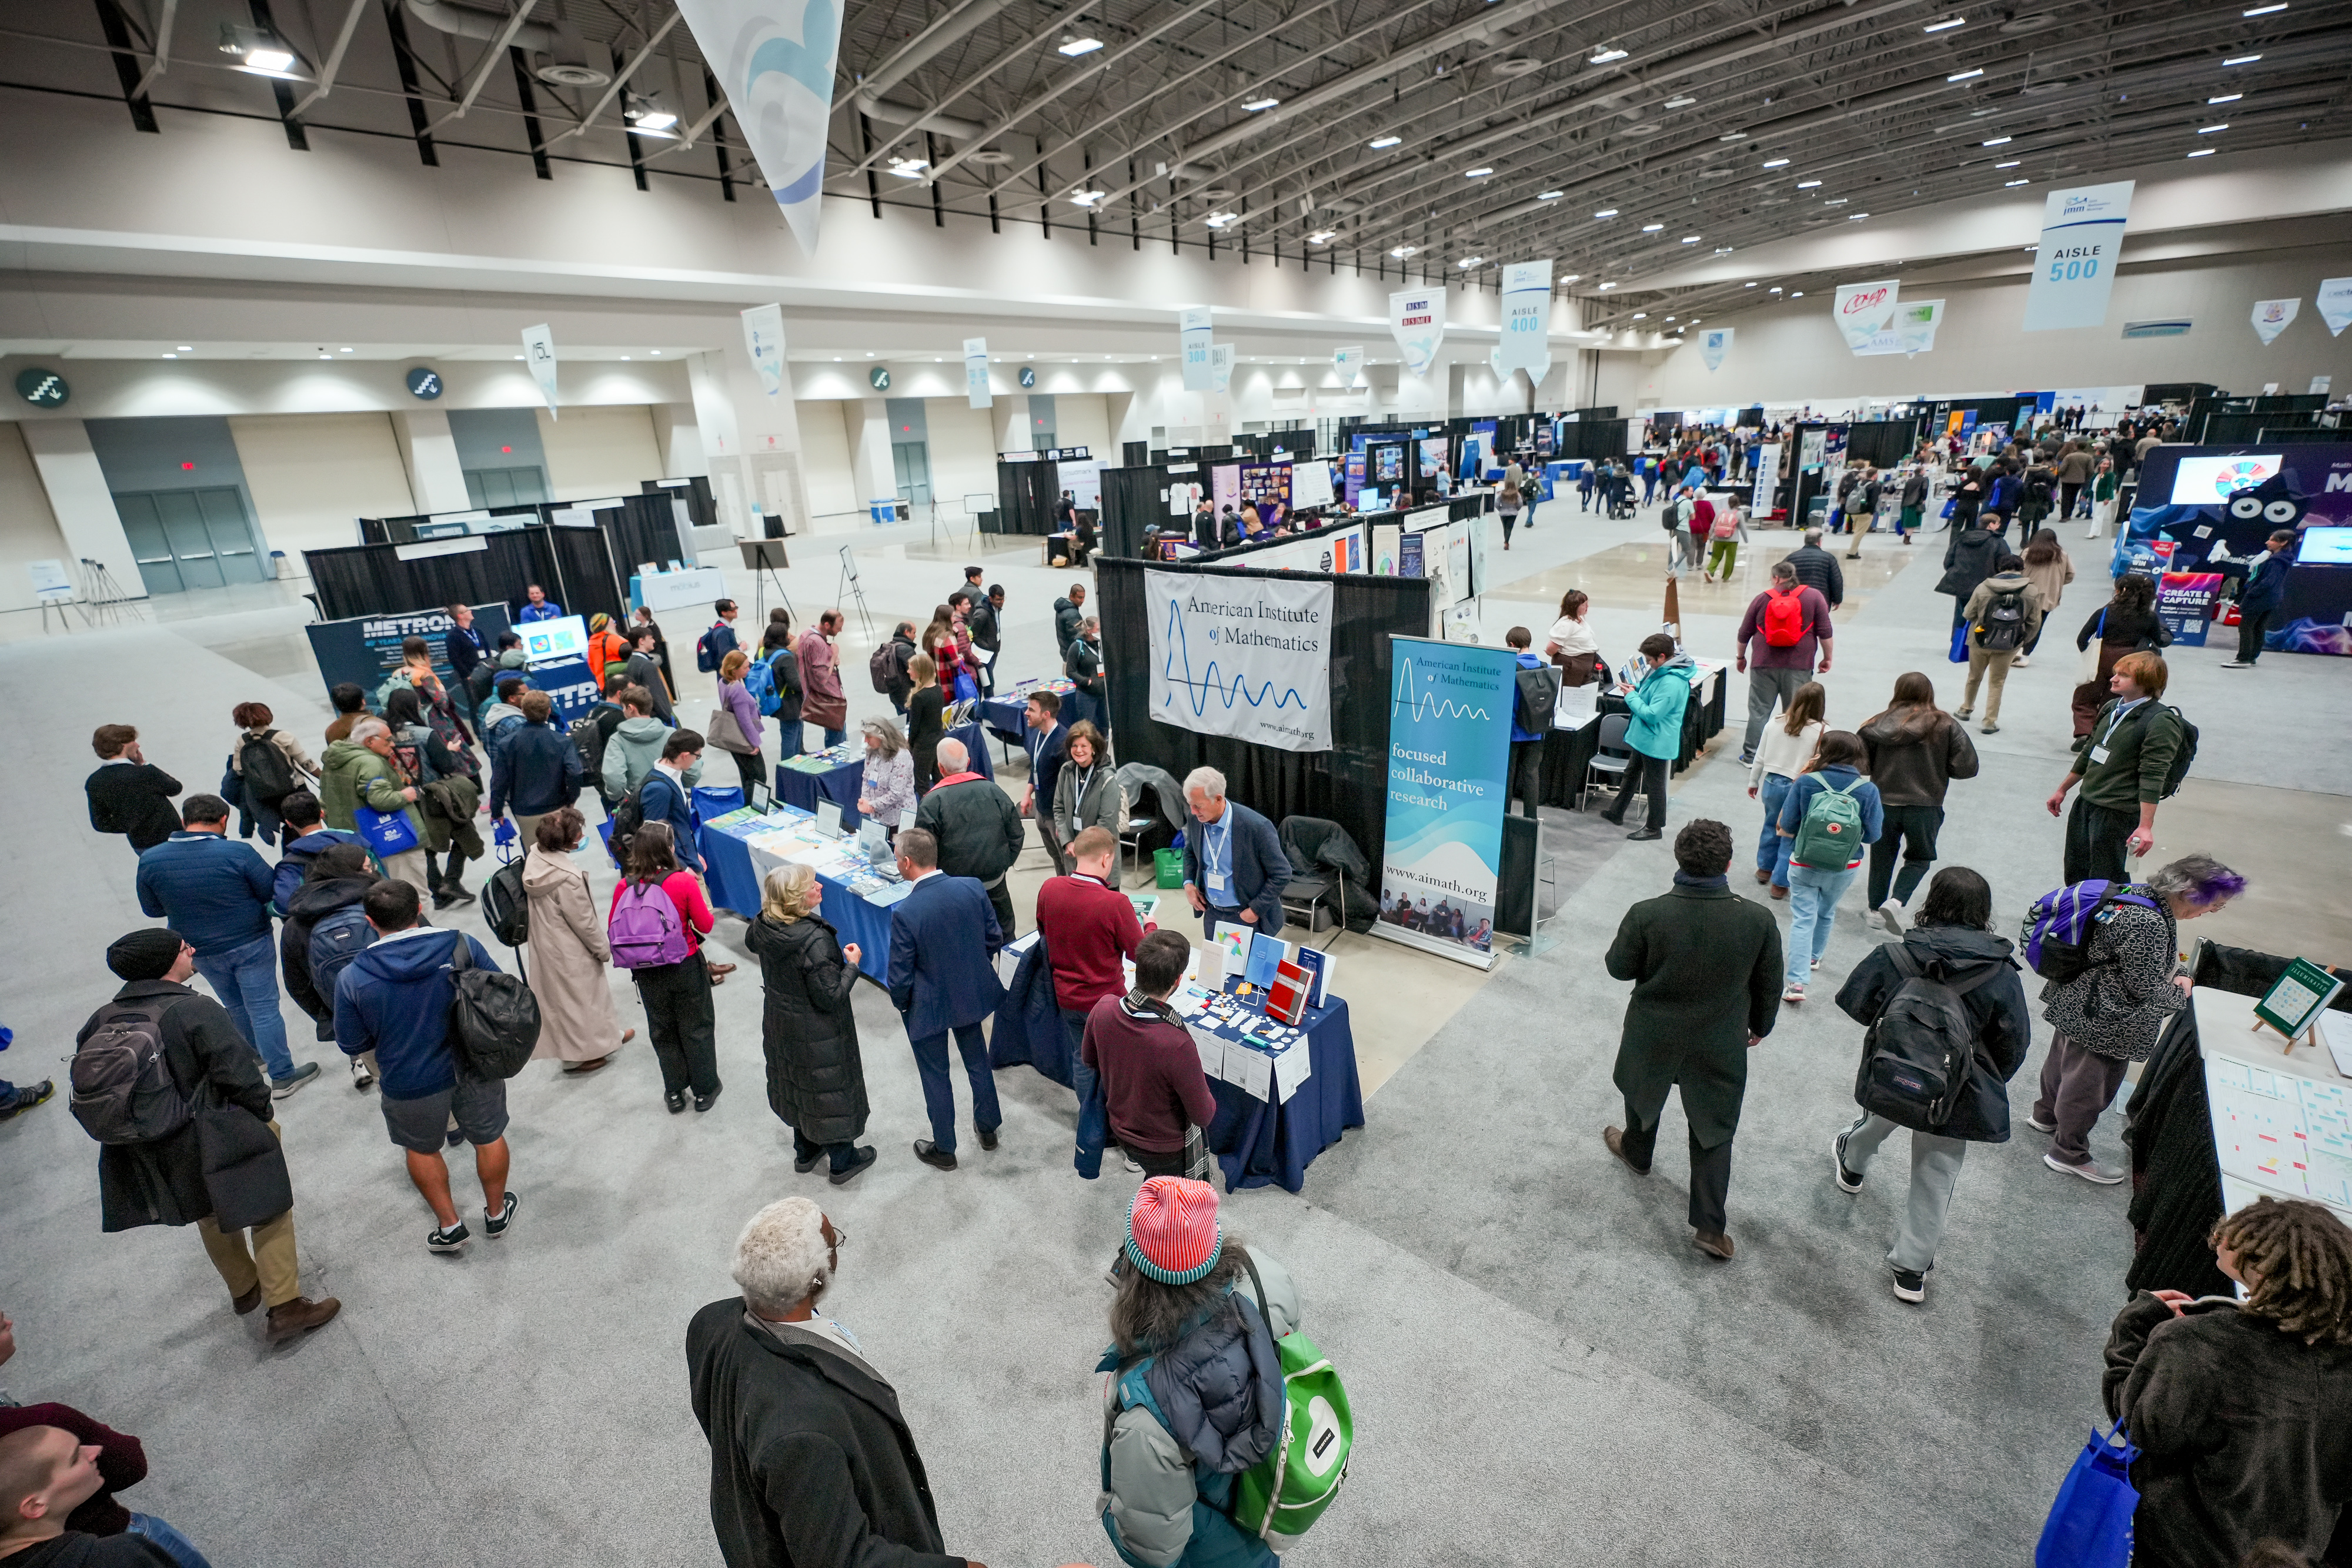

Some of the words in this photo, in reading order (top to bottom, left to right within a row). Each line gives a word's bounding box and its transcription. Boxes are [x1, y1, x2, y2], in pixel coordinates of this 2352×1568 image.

[2054, 246, 2102, 259] AISLE
[2049, 259, 2098, 282] 500
[1512, 307, 1538, 316] AISLE
[1843, 288, 1887, 314] COMAP
[1511, 317, 1537, 332] 400
[1188, 350, 1206, 363] 300
[2162, 597, 2209, 605] CAPTURE
[2164, 589, 2202, 597] CREATE
[1188, 596, 1253, 617] American
[1258, 601, 1318, 623] Institute
[363, 615, 456, 638] METRON
[1210, 627, 1220, 645] of
[1225, 627, 1318, 651] Mathematics
[1416, 657, 1459, 671] American
[1463, 663, 1502, 676] Institute
[1427, 674, 1438, 684] of
[1441, 675, 1499, 691] Mathematics
[1392, 743, 1446, 765] focused
[1391, 767, 1484, 796] collaborative
[1390, 790, 1447, 811] research
[1386, 866, 1487, 903] www.aimath.org
[2291, 967, 2327, 991] ILLUMINATED
